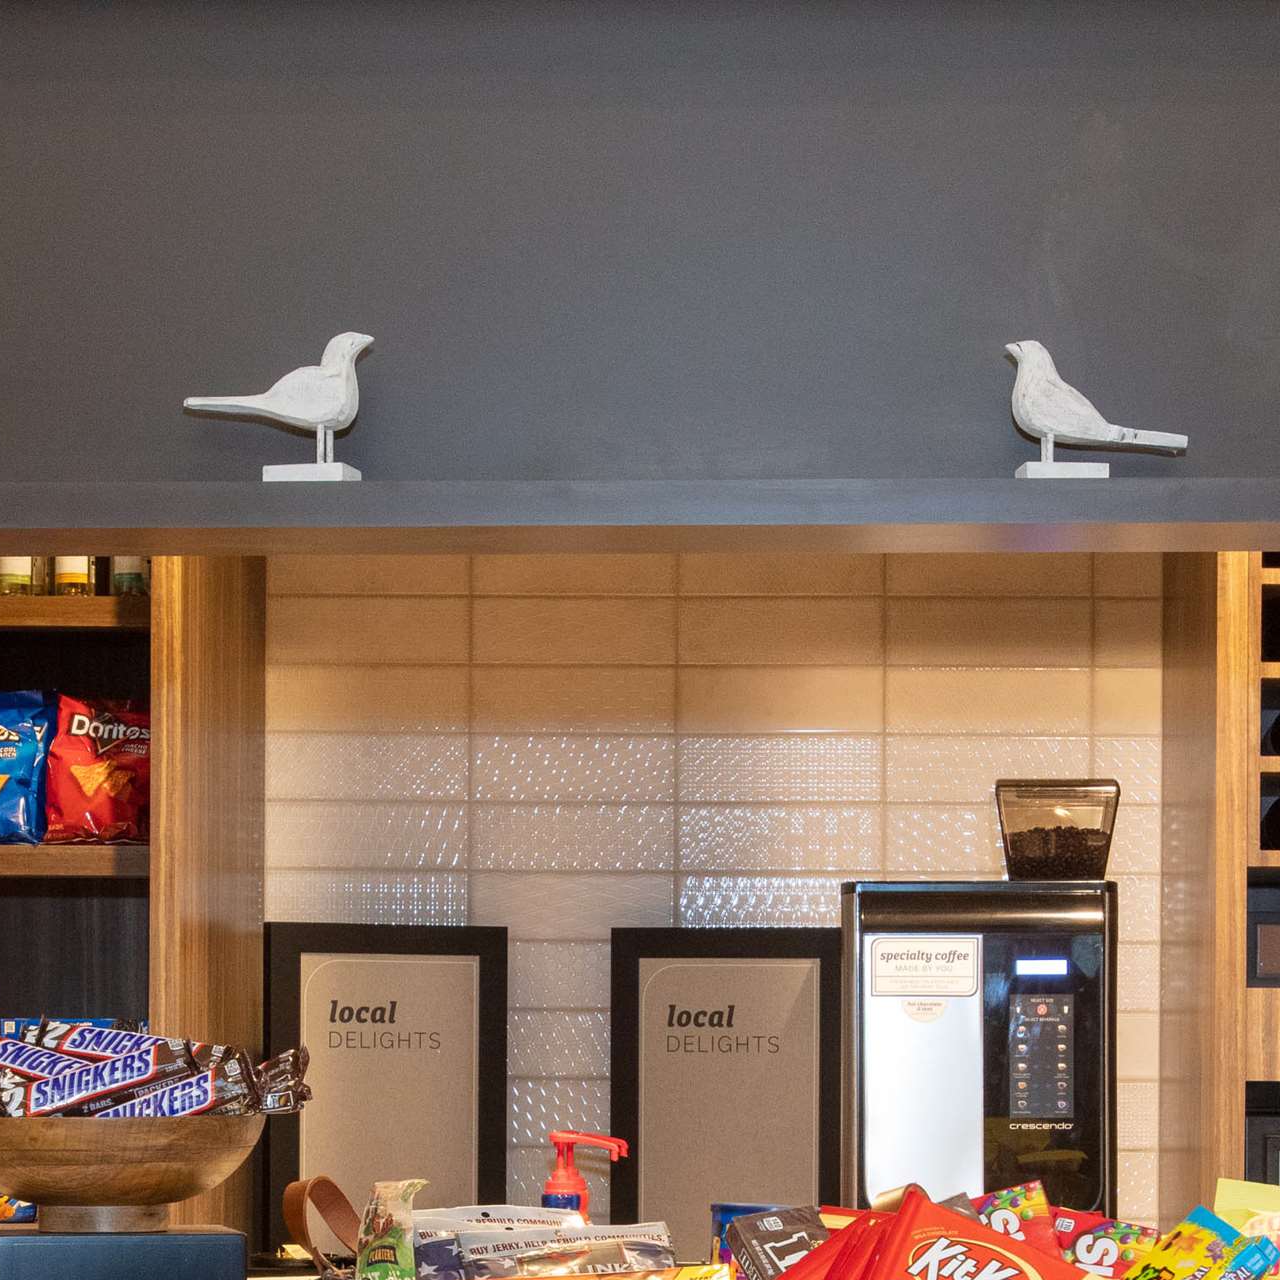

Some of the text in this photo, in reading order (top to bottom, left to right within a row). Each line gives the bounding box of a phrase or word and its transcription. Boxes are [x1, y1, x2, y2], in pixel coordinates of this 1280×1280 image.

[72, 714, 151, 739] Doritos
[880, 949, 969, 963] specialty coffee
[328, 1000, 397, 1025] local
[666, 1004, 735, 1029] local
[328, 1031, 441, 1050] DELIGHTS
[666, 1035, 781, 1054] DELIGHTS
[34, 1047, 154, 1110] SNICKERS
[1009, 1121, 1074, 1131] crescendo
[469, 1246, 489, 1257] BUY
